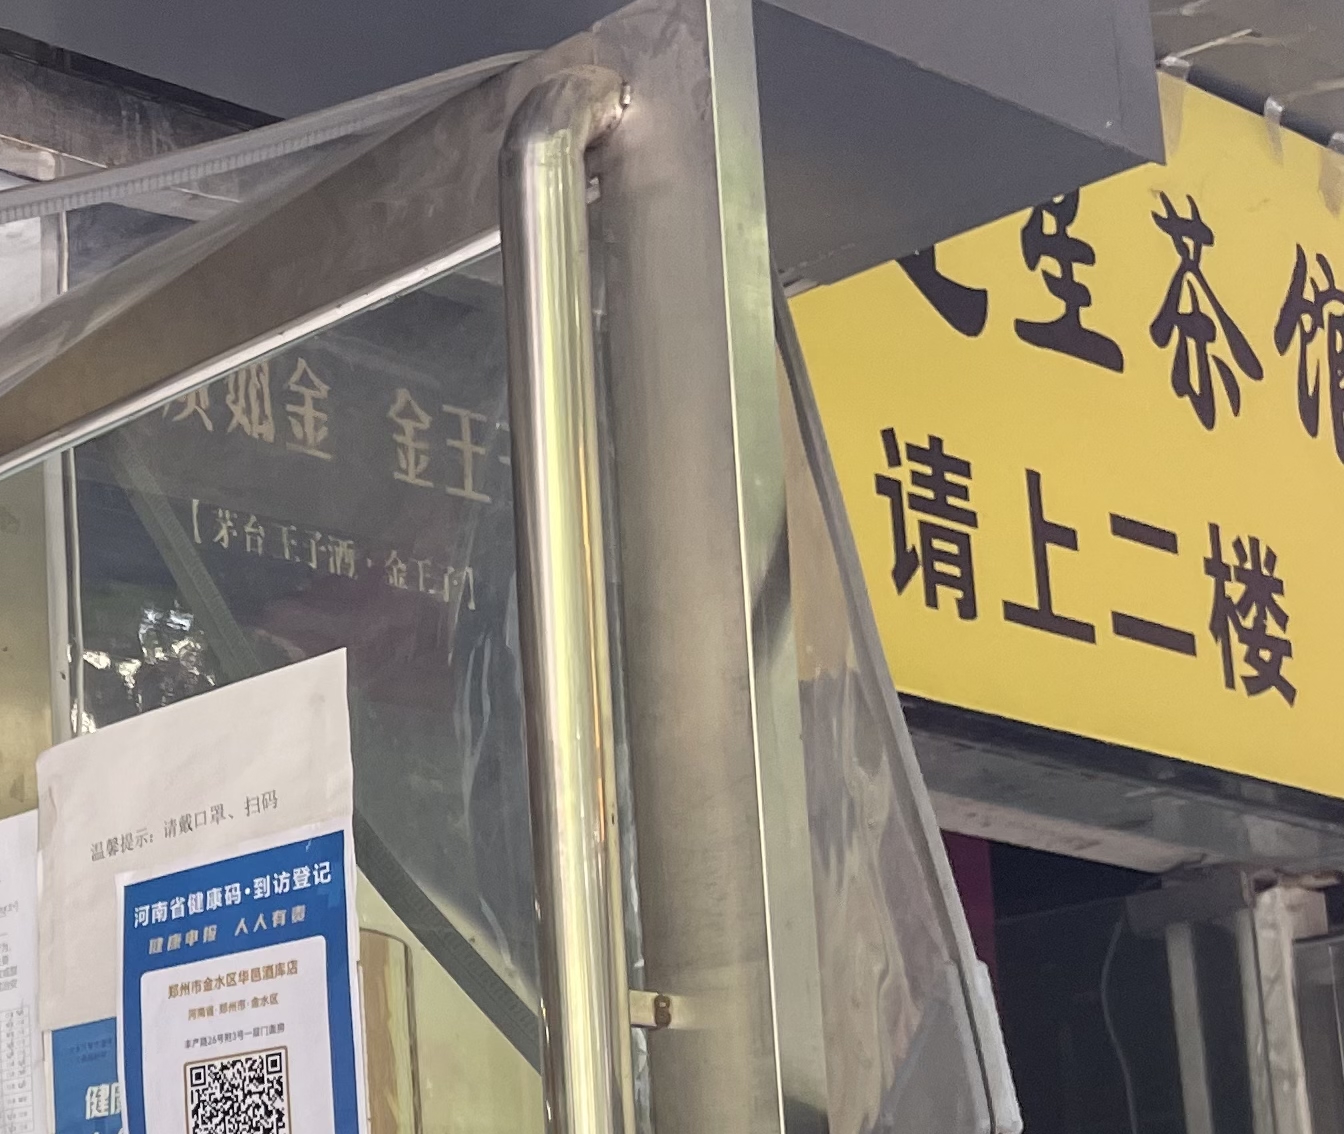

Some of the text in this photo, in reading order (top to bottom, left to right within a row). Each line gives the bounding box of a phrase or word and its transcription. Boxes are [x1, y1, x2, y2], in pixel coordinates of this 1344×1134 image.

[894, 187, 1344, 464] 星茶馆
[875, 427, 1296, 707] 请上二楼
[134, 861, 332, 928] 河南省健康码·到访登记
[149, 904, 306, 955] 健康申报 人人有责
